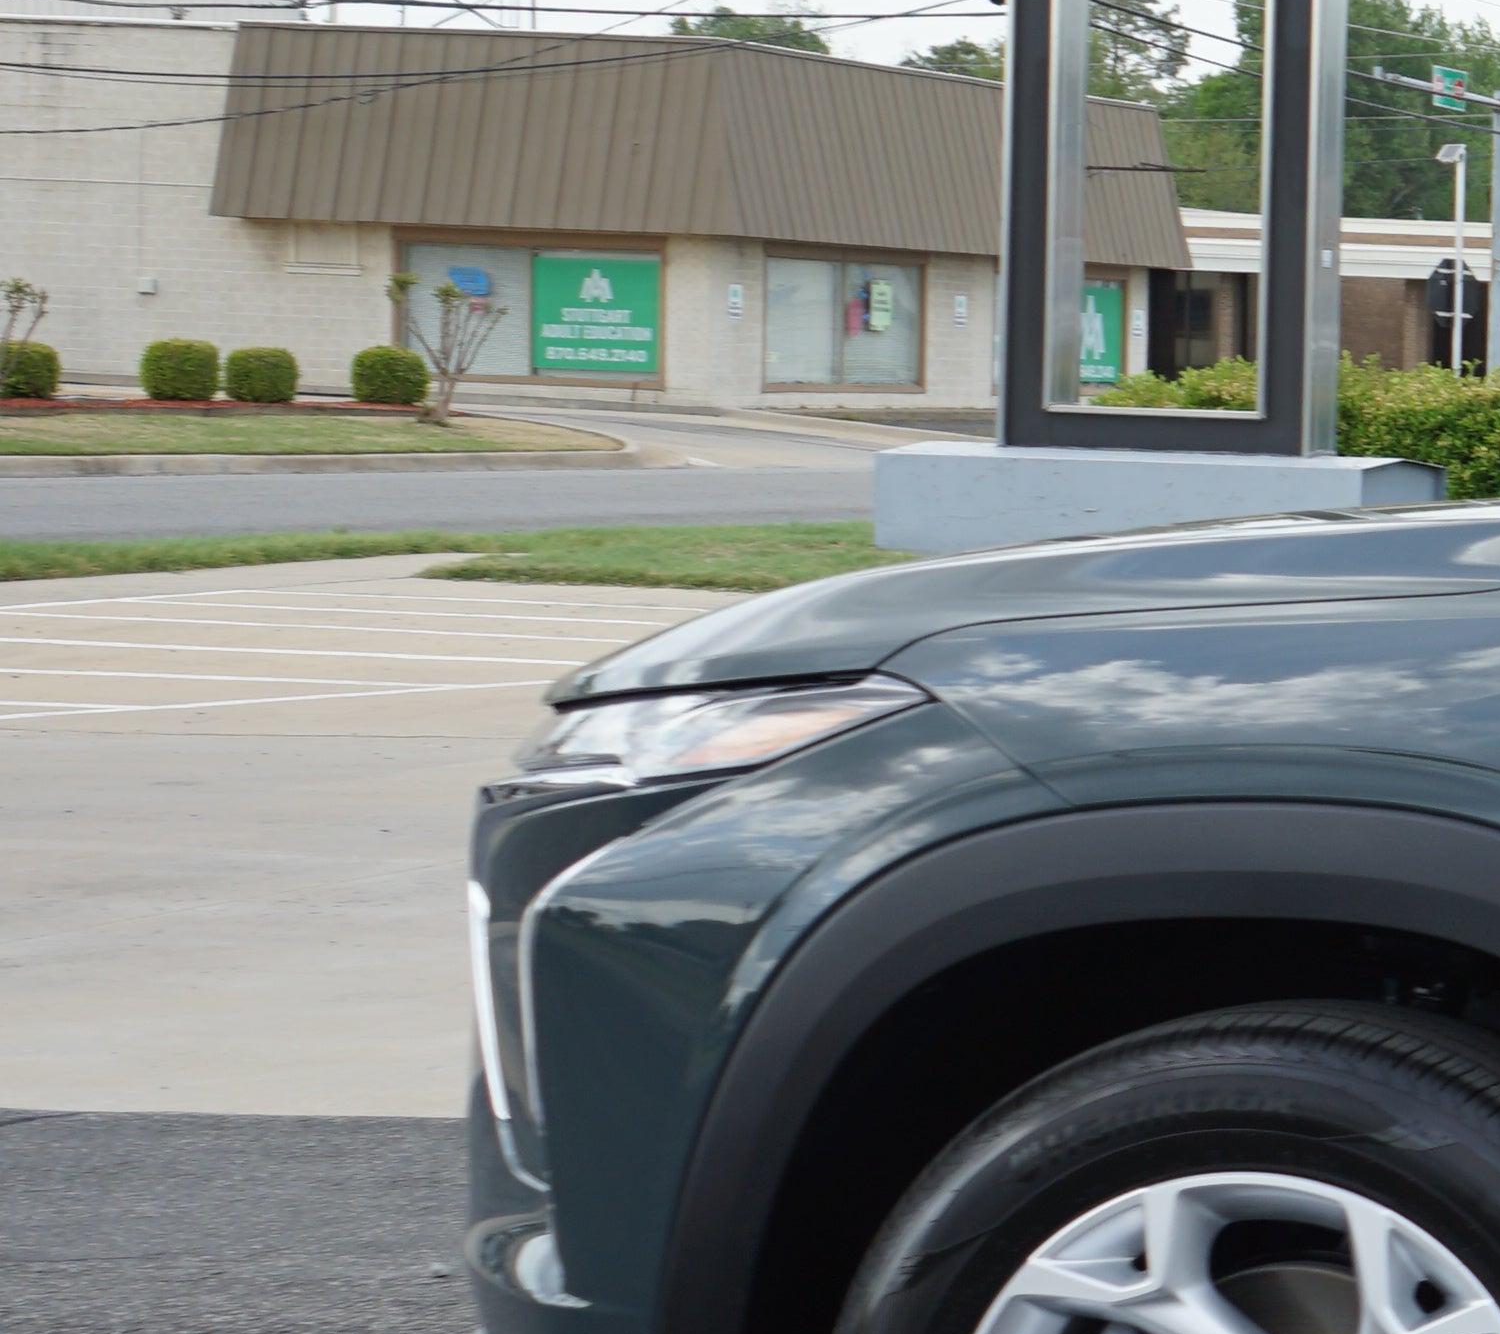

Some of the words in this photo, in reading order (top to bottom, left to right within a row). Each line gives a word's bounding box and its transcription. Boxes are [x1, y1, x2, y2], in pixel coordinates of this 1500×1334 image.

[561, 307, 632, 323] STUTTGART
[541, 323, 581, 339] ADULT
[583, 325, 653, 341] EDUCATION
